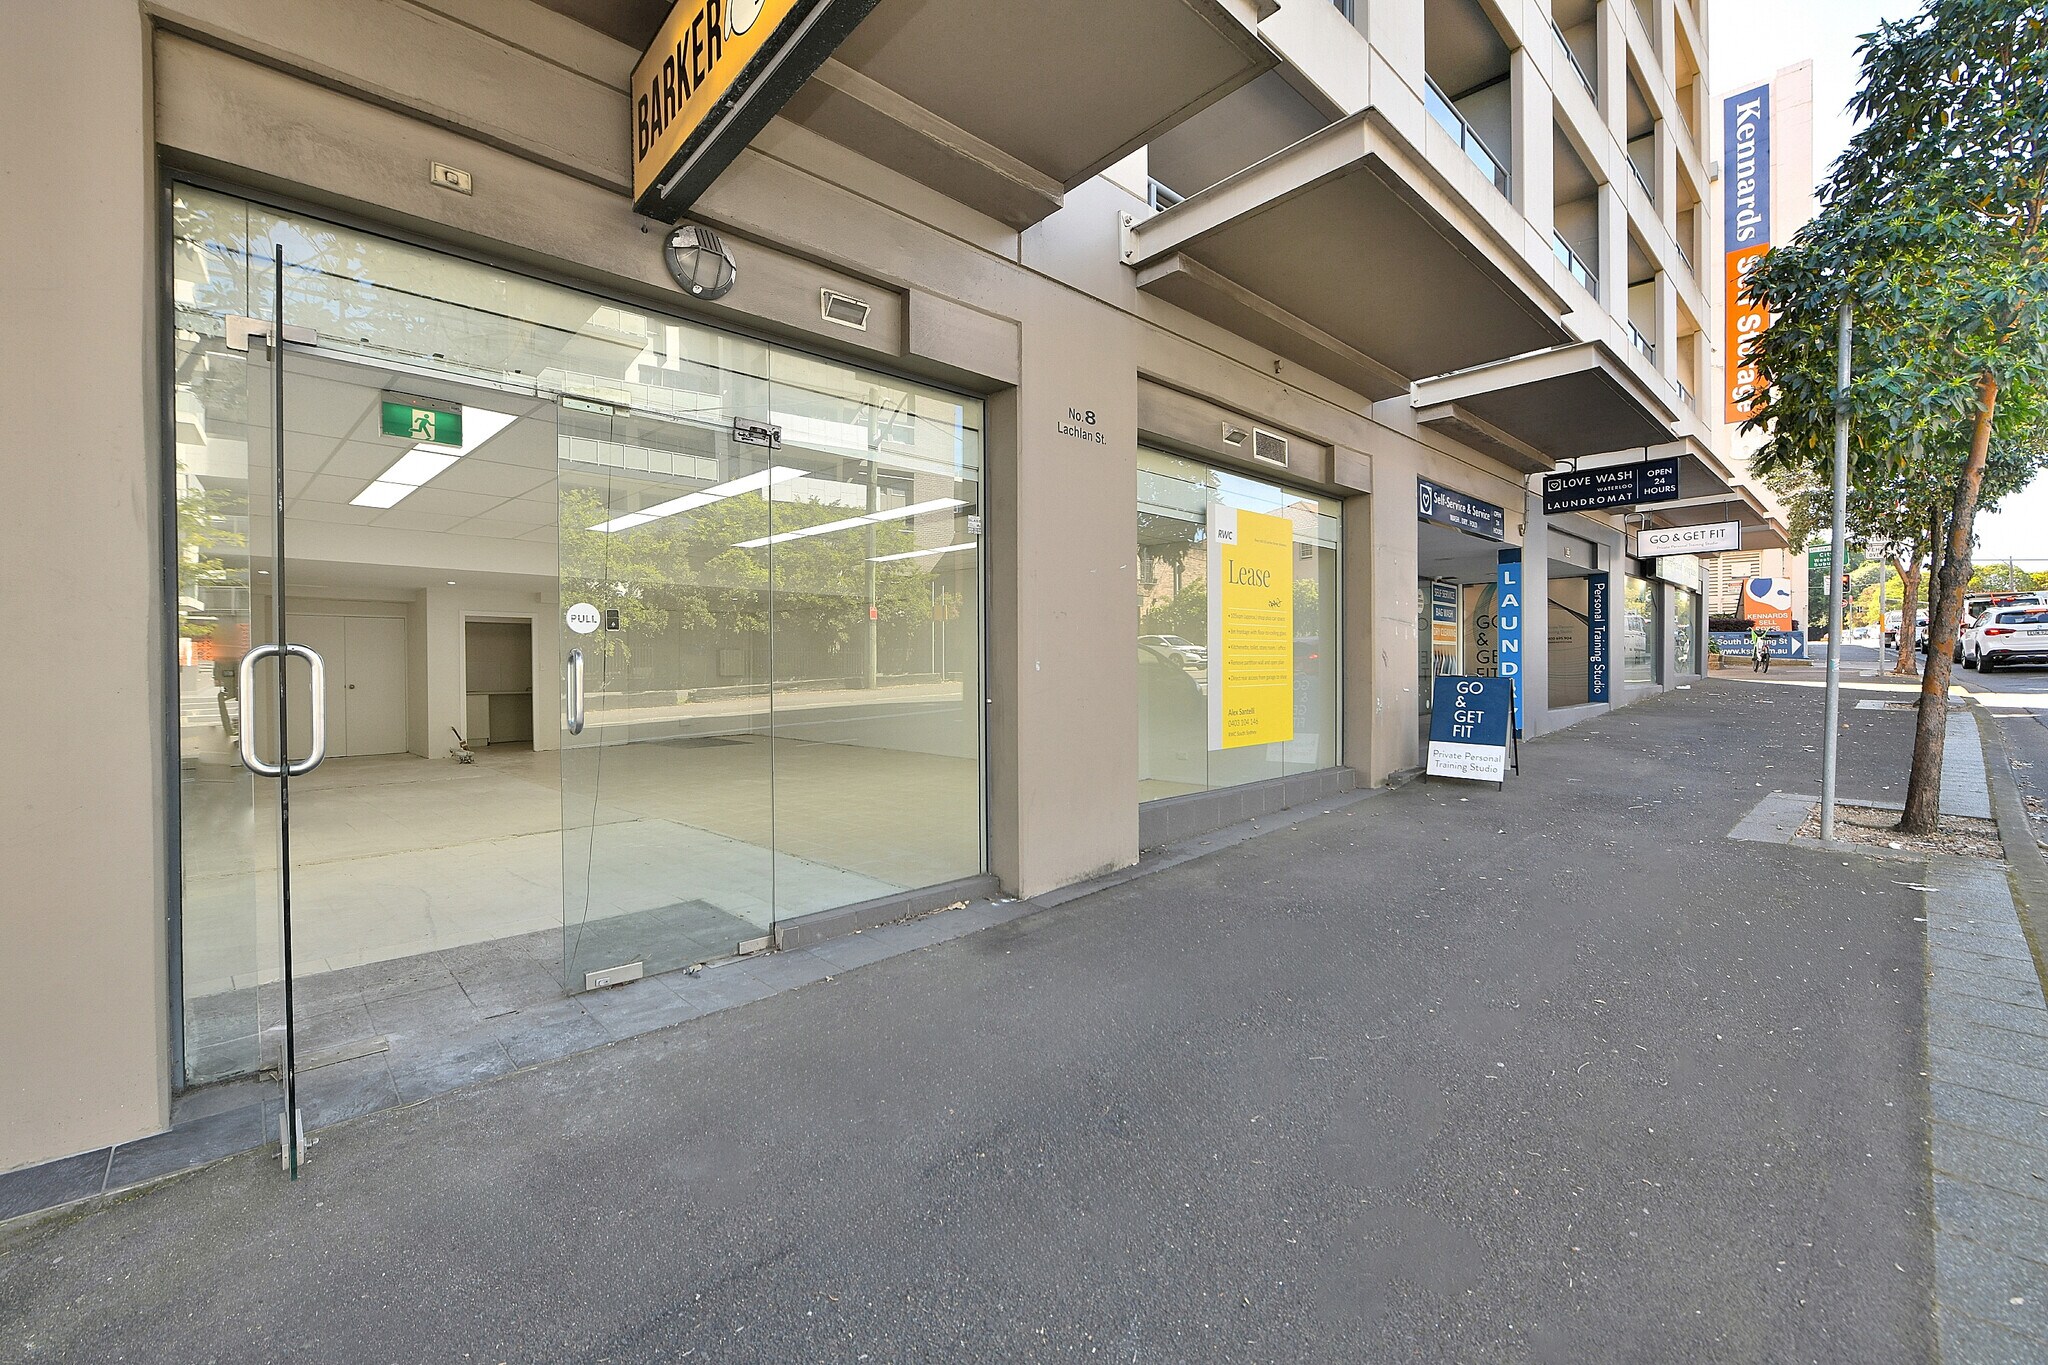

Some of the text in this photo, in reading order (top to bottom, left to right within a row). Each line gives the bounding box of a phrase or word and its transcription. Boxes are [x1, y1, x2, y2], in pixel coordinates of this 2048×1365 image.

[638, 0, 722, 161] BARKER
[1736, 96, 1761, 242] Kennards
[1057, 421, 1107, 445] Lachlan St.
[1562, 470, 1633, 488] LOVE WASH
[1646, 467, 1673, 477] OPEN
[1596, 483, 1633, 492] WATERLOO
[1654, 477, 1666, 485] 24
[1644, 484, 1676, 495] HOURS
[1433, 491, 1491, 521] Self-Service & Service
[1547, 493, 1633, 510] LAUNDROMAT
[1218, 529, 1233, 540] RWC
[1649, 528, 1726, 544] GO & GET FIT
[1228, 559, 1271, 588] Lease
[570, 614, 598, 624] PULL
[1476, 632, 1488, 646] &
[1590, 582, 1606, 694] Personal Training Studio
[1476, 650, 1497, 664] GE
[1456, 681, 1484, 695] GO
[1455, 695, 1467, 708] &
[1454, 710, 1485, 724] GET
[1452, 724, 1474, 738] FIT
[1433, 749, 1502, 763] Private Personal
[1434, 760, 1498, 774] Training Studio
